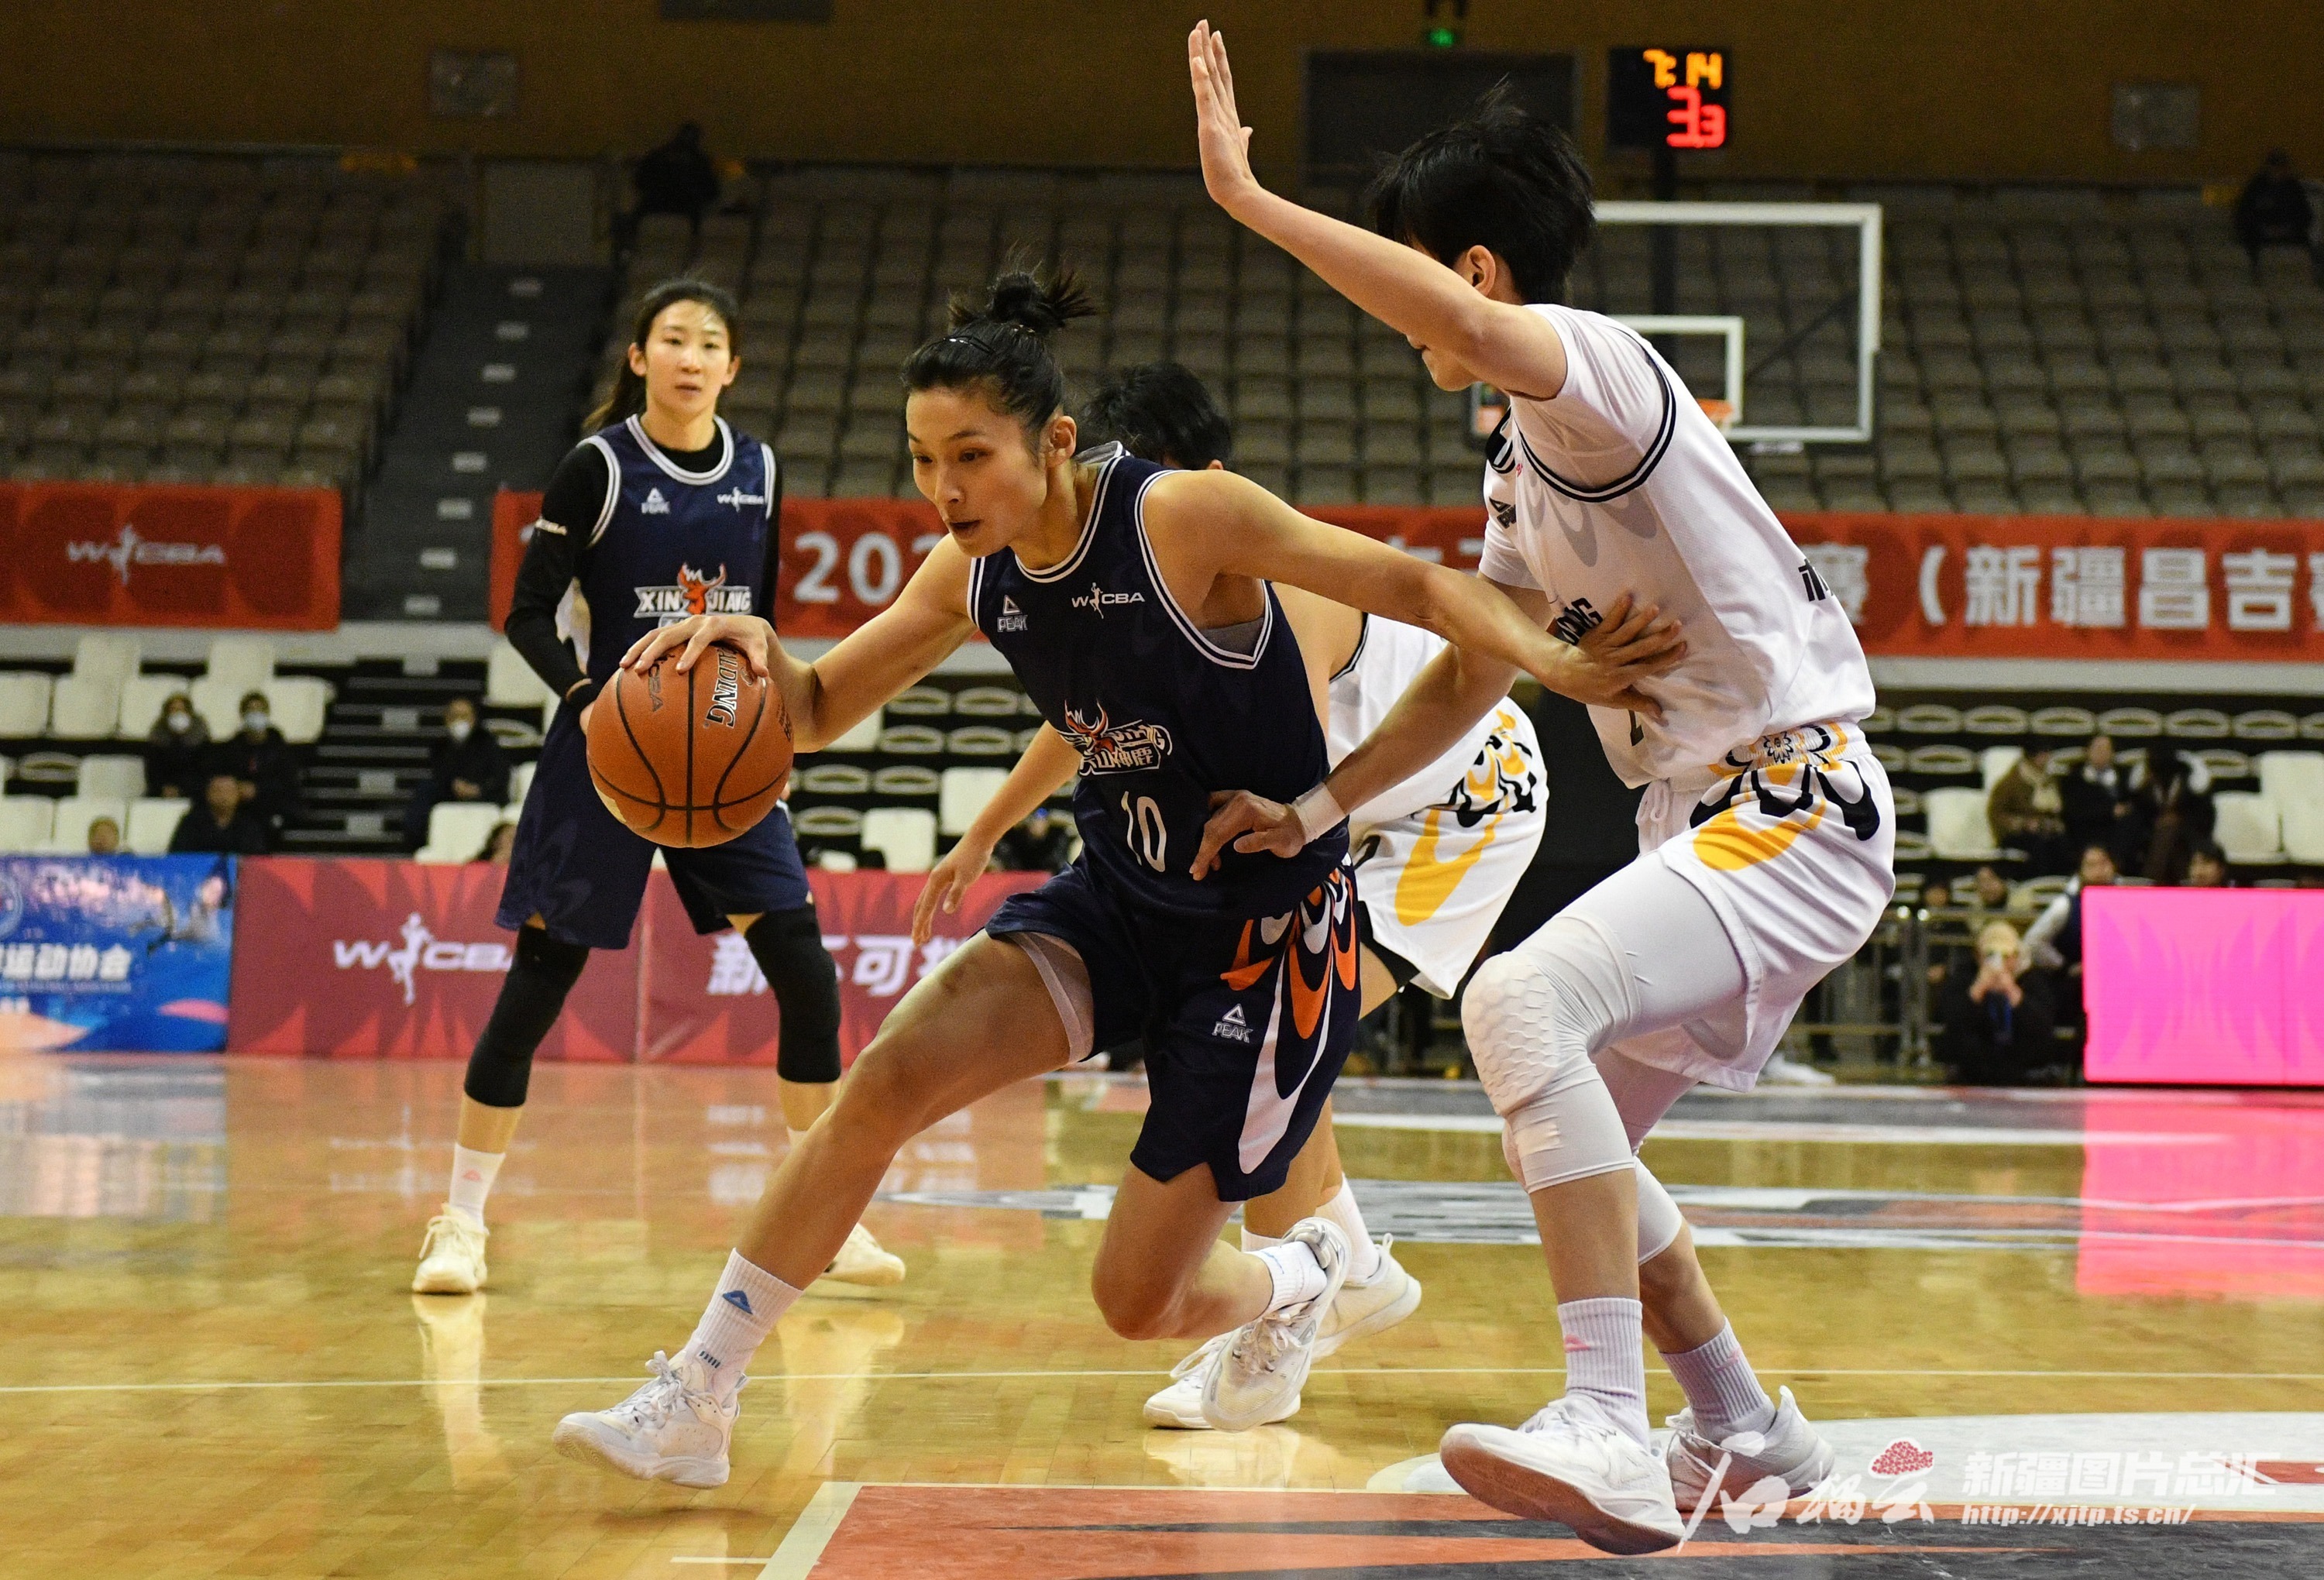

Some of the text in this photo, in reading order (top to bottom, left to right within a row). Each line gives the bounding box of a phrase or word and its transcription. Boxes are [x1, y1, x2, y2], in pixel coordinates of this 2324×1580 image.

[793, 530, 942, 606] 20
[1801, 541, 2324, 632] 赛（新疆昌吉
[997, 615, 1028, 632] PEAK
[705, 646, 737, 729] ALDING
[1121, 791, 1167, 873] 10
[0, 942, 132, 981] 运动协会
[1212, 1021, 1253, 1043] PEAK
